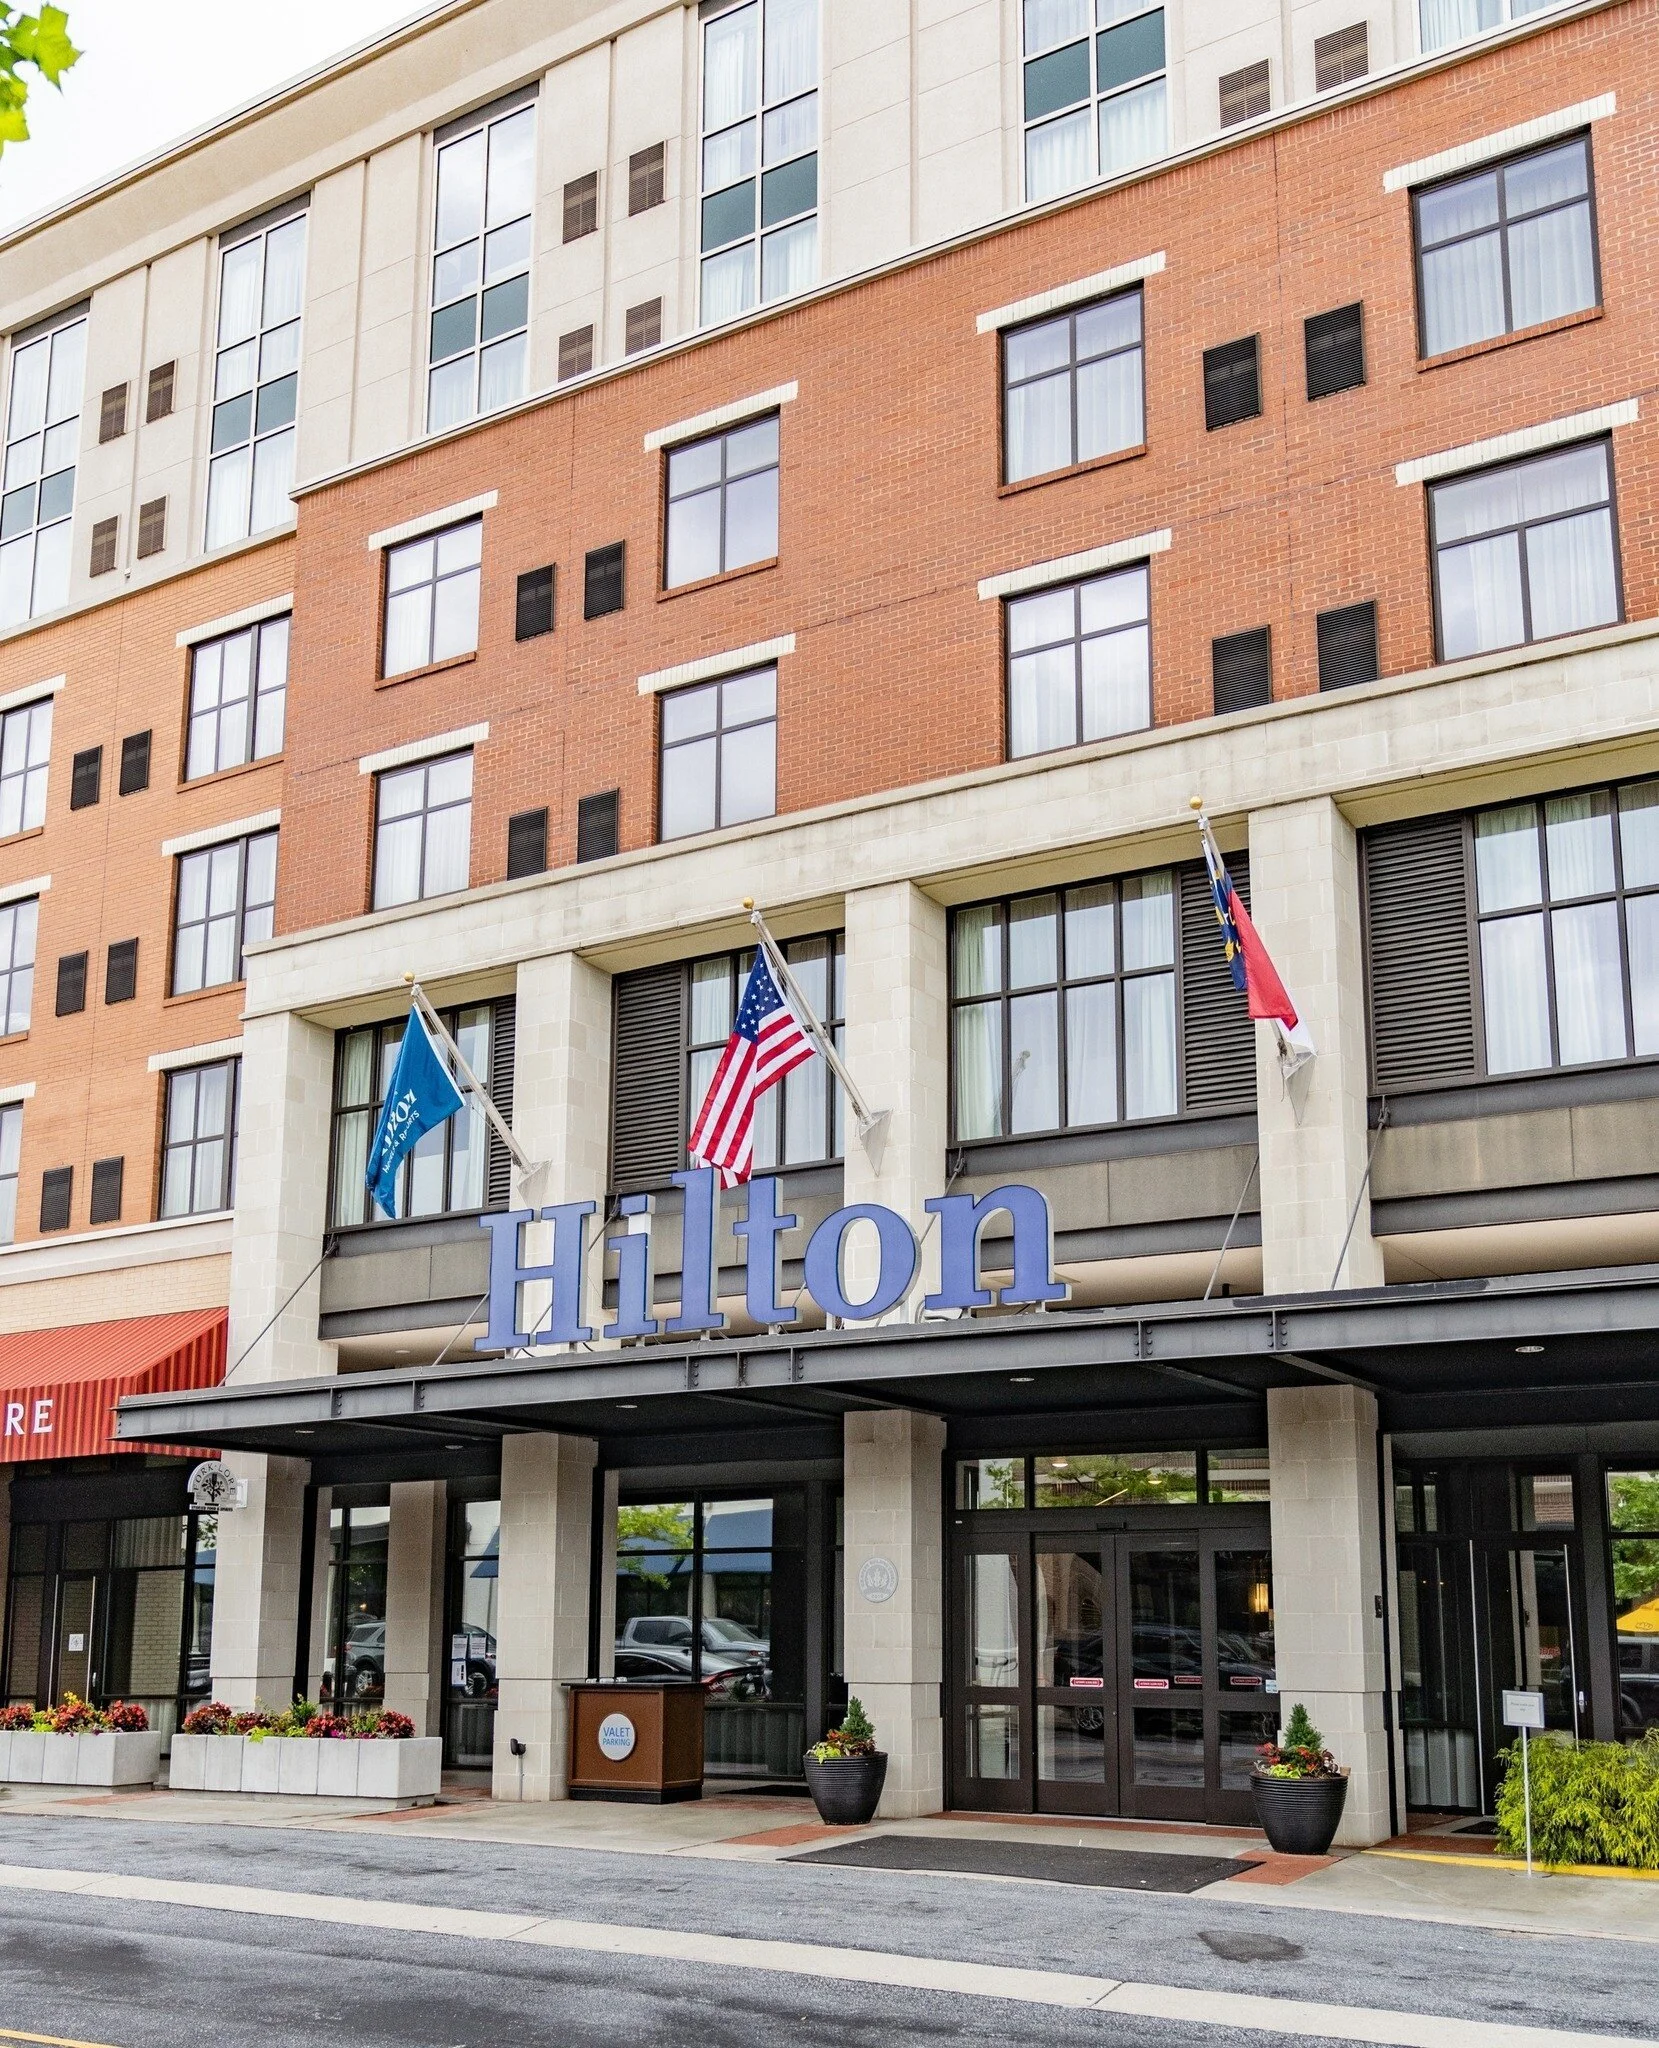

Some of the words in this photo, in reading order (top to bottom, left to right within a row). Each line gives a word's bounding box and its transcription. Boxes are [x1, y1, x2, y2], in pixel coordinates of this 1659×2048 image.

[474, 1167, 1069, 1352] Hilton
[4, 1399, 54, 1436] RE
[602, 1738, 631, 1747] PARKING
[603, 1727, 631, 1738] VALET
